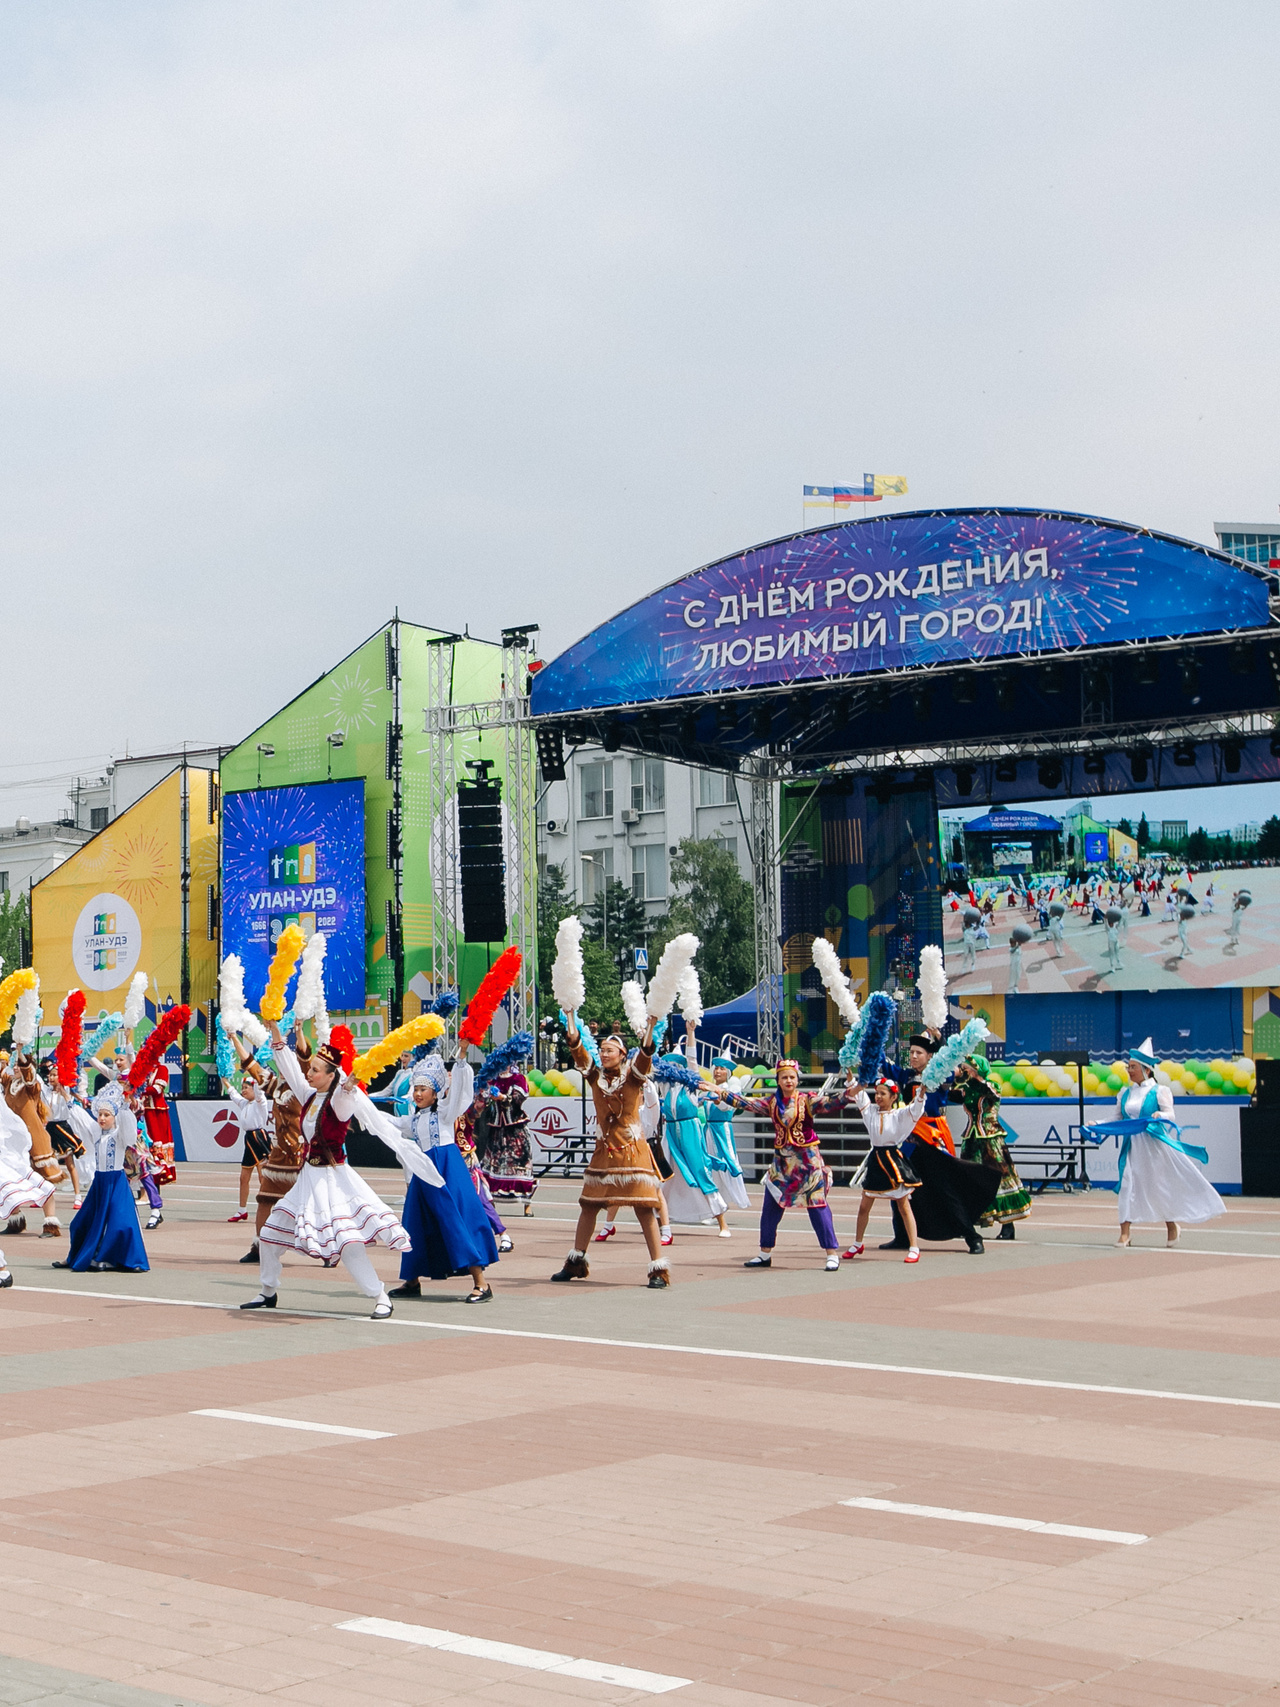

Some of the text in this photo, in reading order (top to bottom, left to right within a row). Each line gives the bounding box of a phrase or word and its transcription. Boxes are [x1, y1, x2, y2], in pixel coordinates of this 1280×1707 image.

[683, 548, 1058, 629] С ДНЁМ РОЖДЕНИЯ,
[695, 598, 1043, 672] ЛЮБИМЫЙ ГОРОД!
[249, 887, 336, 909] УЛАН-УДЭ
[251, 921, 267, 931] 1666
[318, 916, 336, 926] 2022
[85, 936, 127, 948] УЛАН-УДЭ
